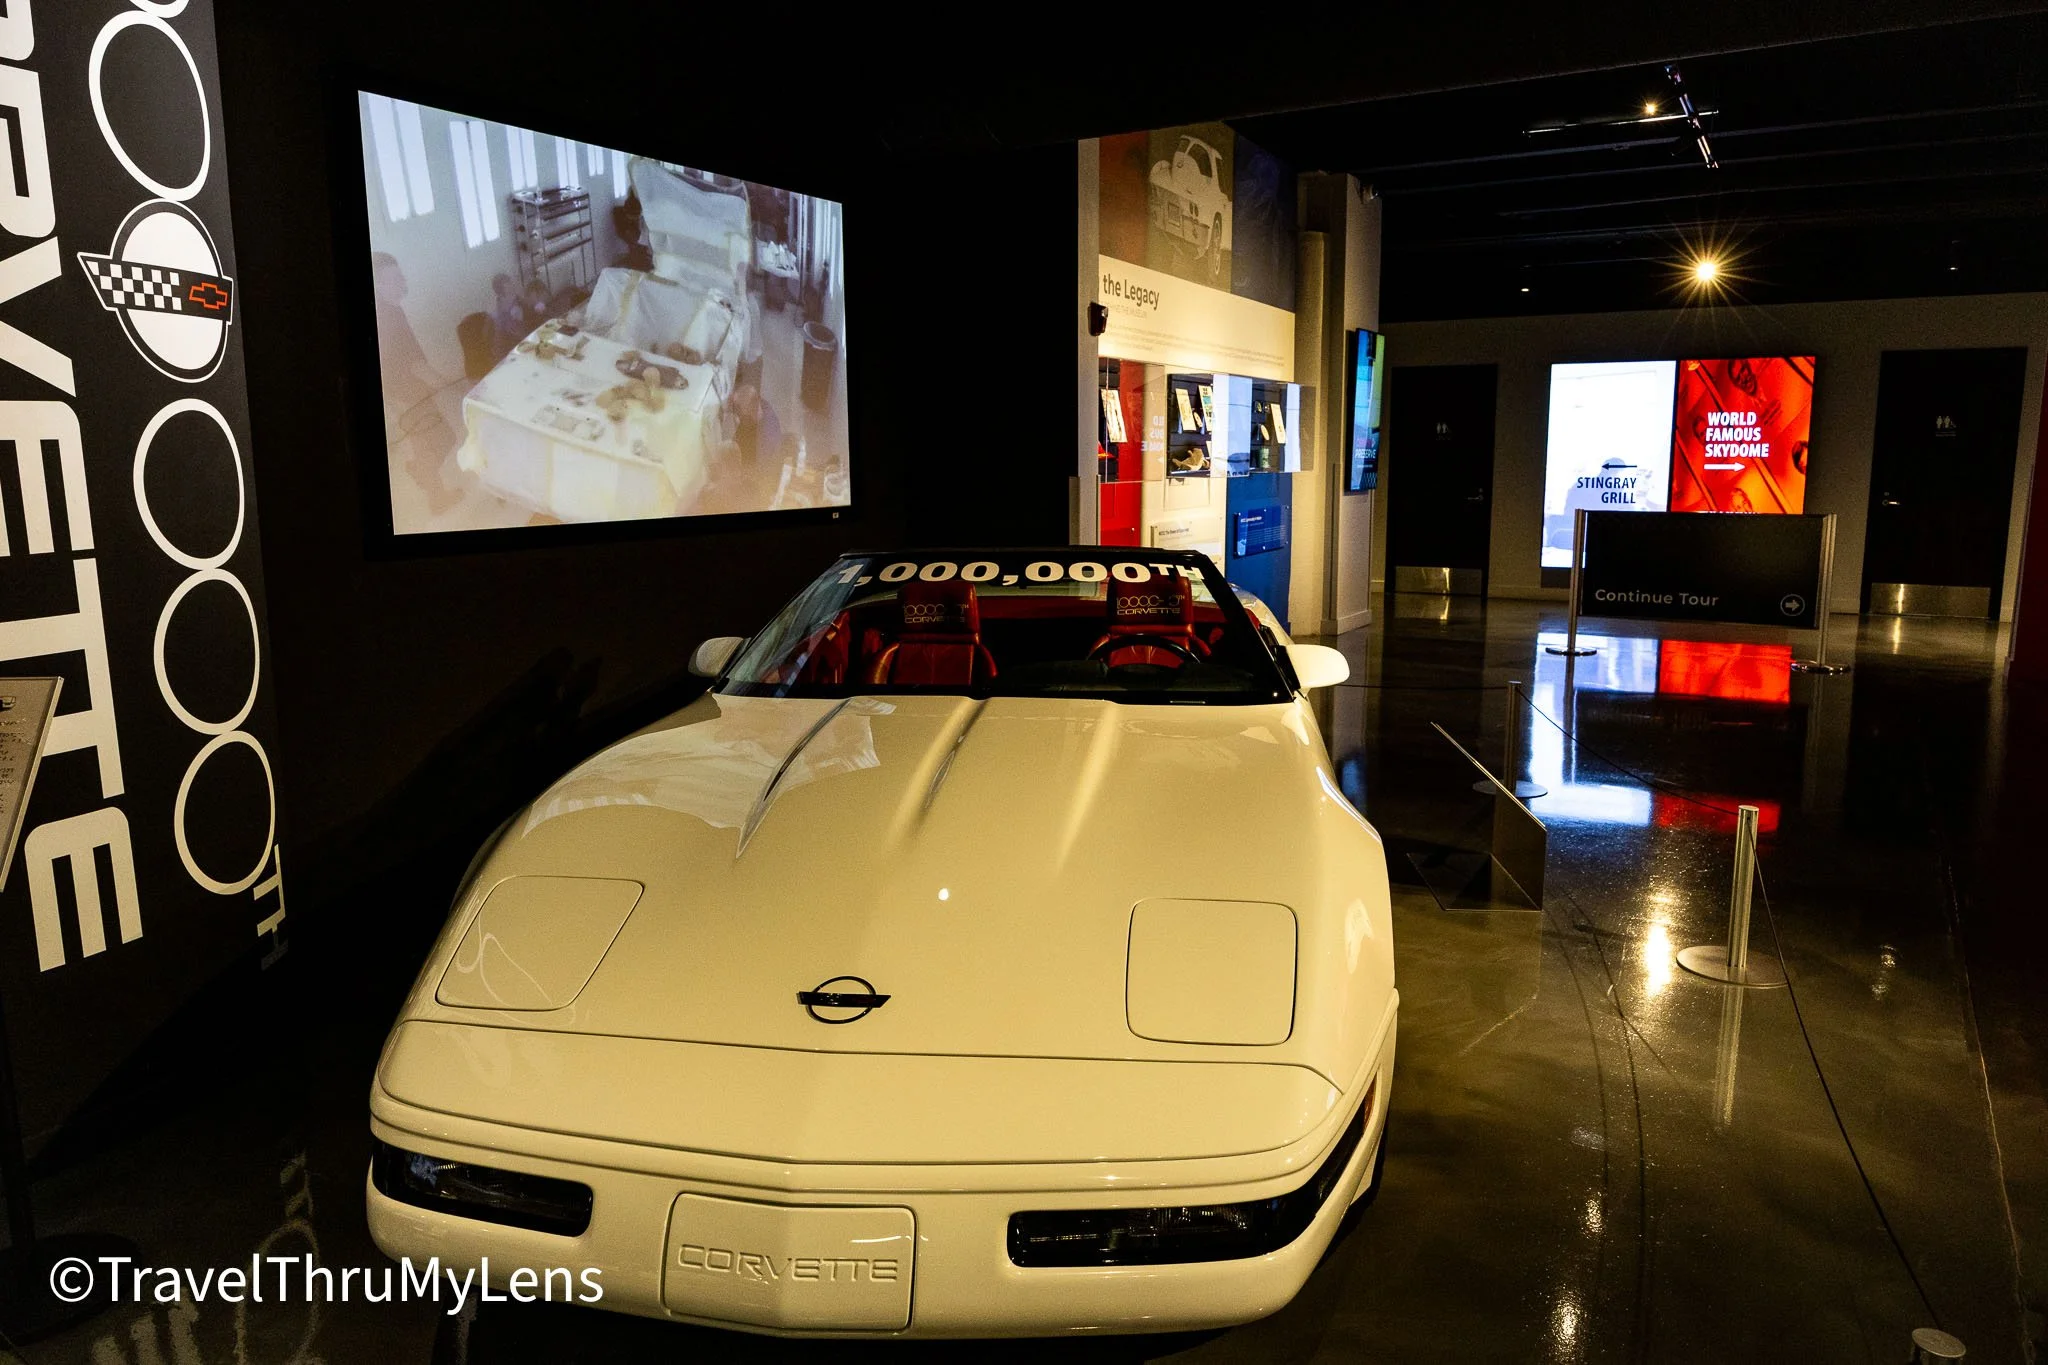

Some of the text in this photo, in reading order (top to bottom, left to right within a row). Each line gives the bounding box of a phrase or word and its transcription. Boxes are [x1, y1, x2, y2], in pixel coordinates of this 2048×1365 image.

[1103, 273, 1121, 297] the
[1124, 278, 1160, 311] Legacy
[1707, 412, 1757, 426] WORLD
[1705, 427, 1761, 442] FAMOUS
[1705, 443, 1769, 458] SKYDOME
[1577, 476, 1637, 489] STINGRAY
[1601, 491, 1637, 504] GRILL
[838, 561, 1204, 587] 1,000,000TH
[1595, 589, 1719, 607] Continue Tour
[678, 1244, 899, 1283] CORVETTE
